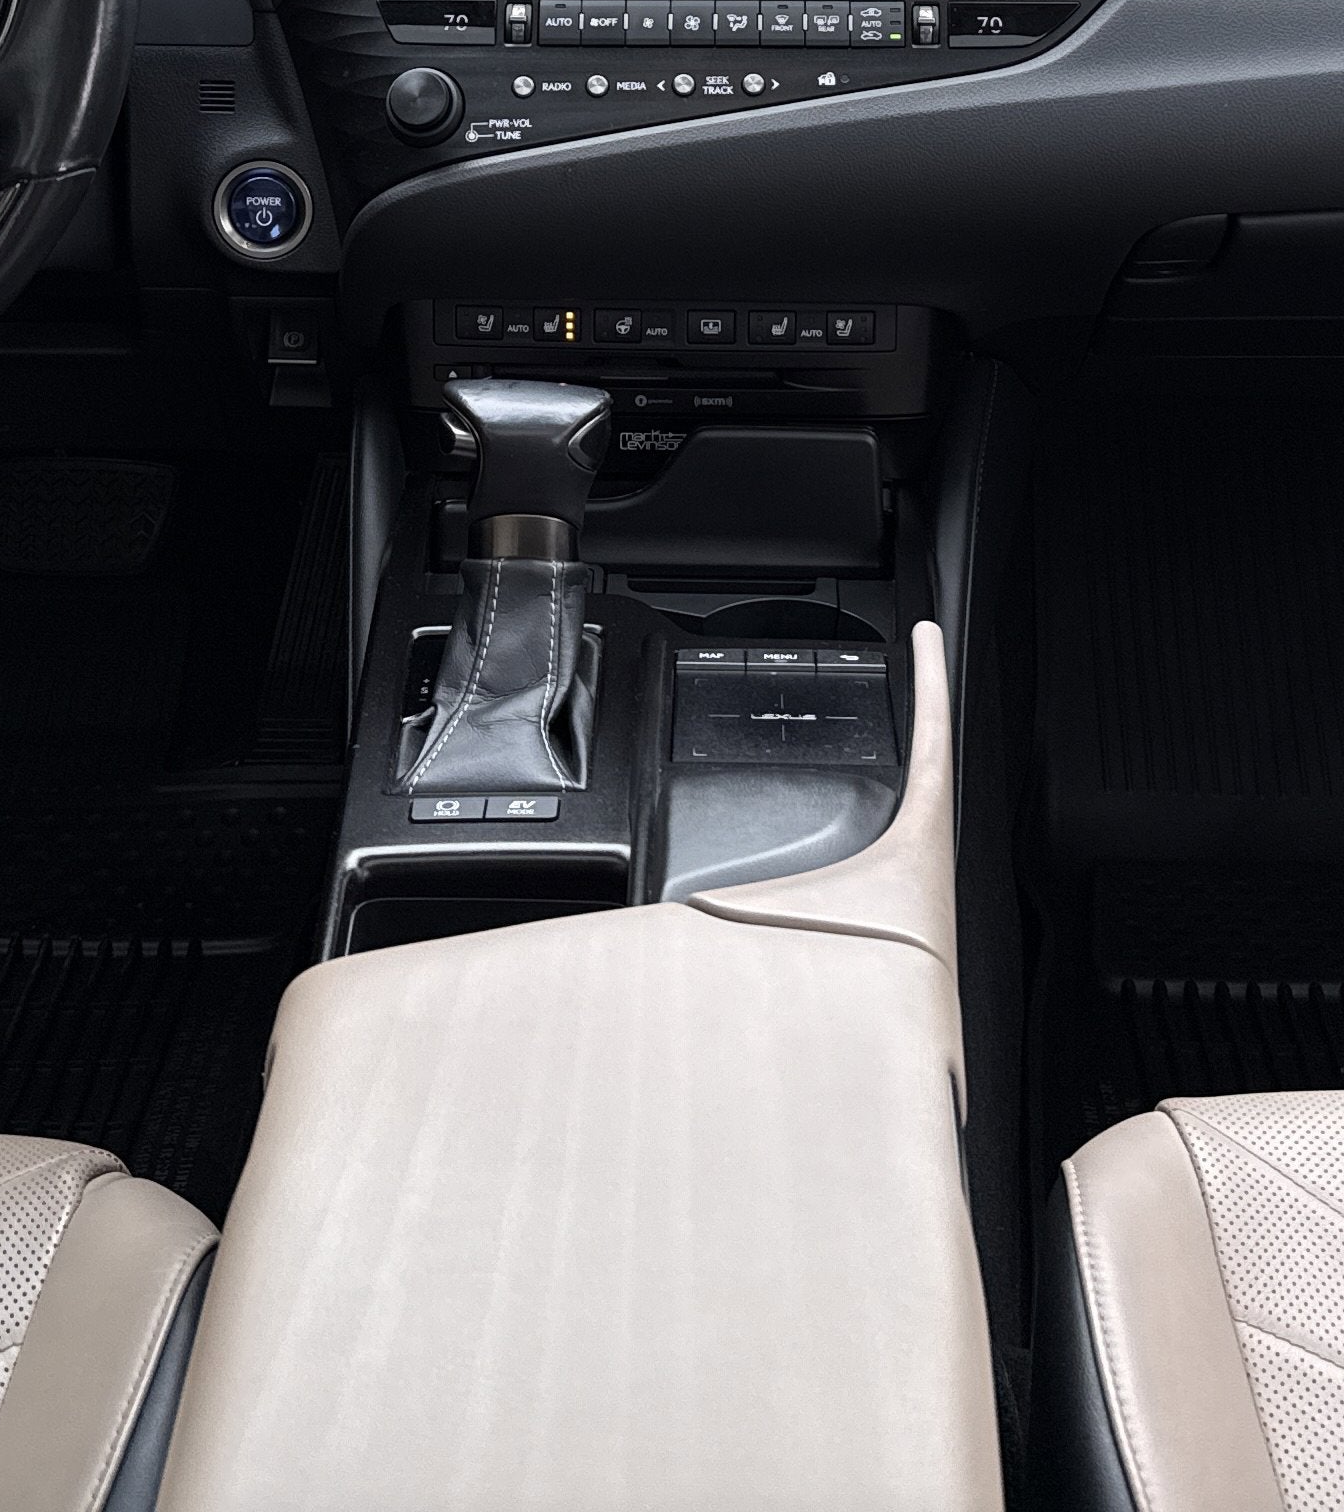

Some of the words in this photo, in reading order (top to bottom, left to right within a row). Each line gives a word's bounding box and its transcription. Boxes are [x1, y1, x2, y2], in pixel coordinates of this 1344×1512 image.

[443, 14, 469, 31] 70
[545, 17, 573, 27] AUTO
[598, 17, 619, 27] OFF
[861, 20, 882, 28] AUTO
[976, 16, 1003, 34] 70
[771, 24, 794, 32] FRONT
[706, 75, 730, 85] SEEK
[541, 81, 572, 92] RADIO
[616, 81, 647, 91] MEDIA
[702, 85, 735, 96] TRACK
[496, 130, 522, 140] TUNE
[246, 196, 282, 206] POWER
[507, 324, 530, 333] AUTO
[646, 327, 668, 336] AUTO
[801, 329, 823, 338] AUTO
[508, 800, 537, 809] EV
[433, 809, 460, 817] HOLD
